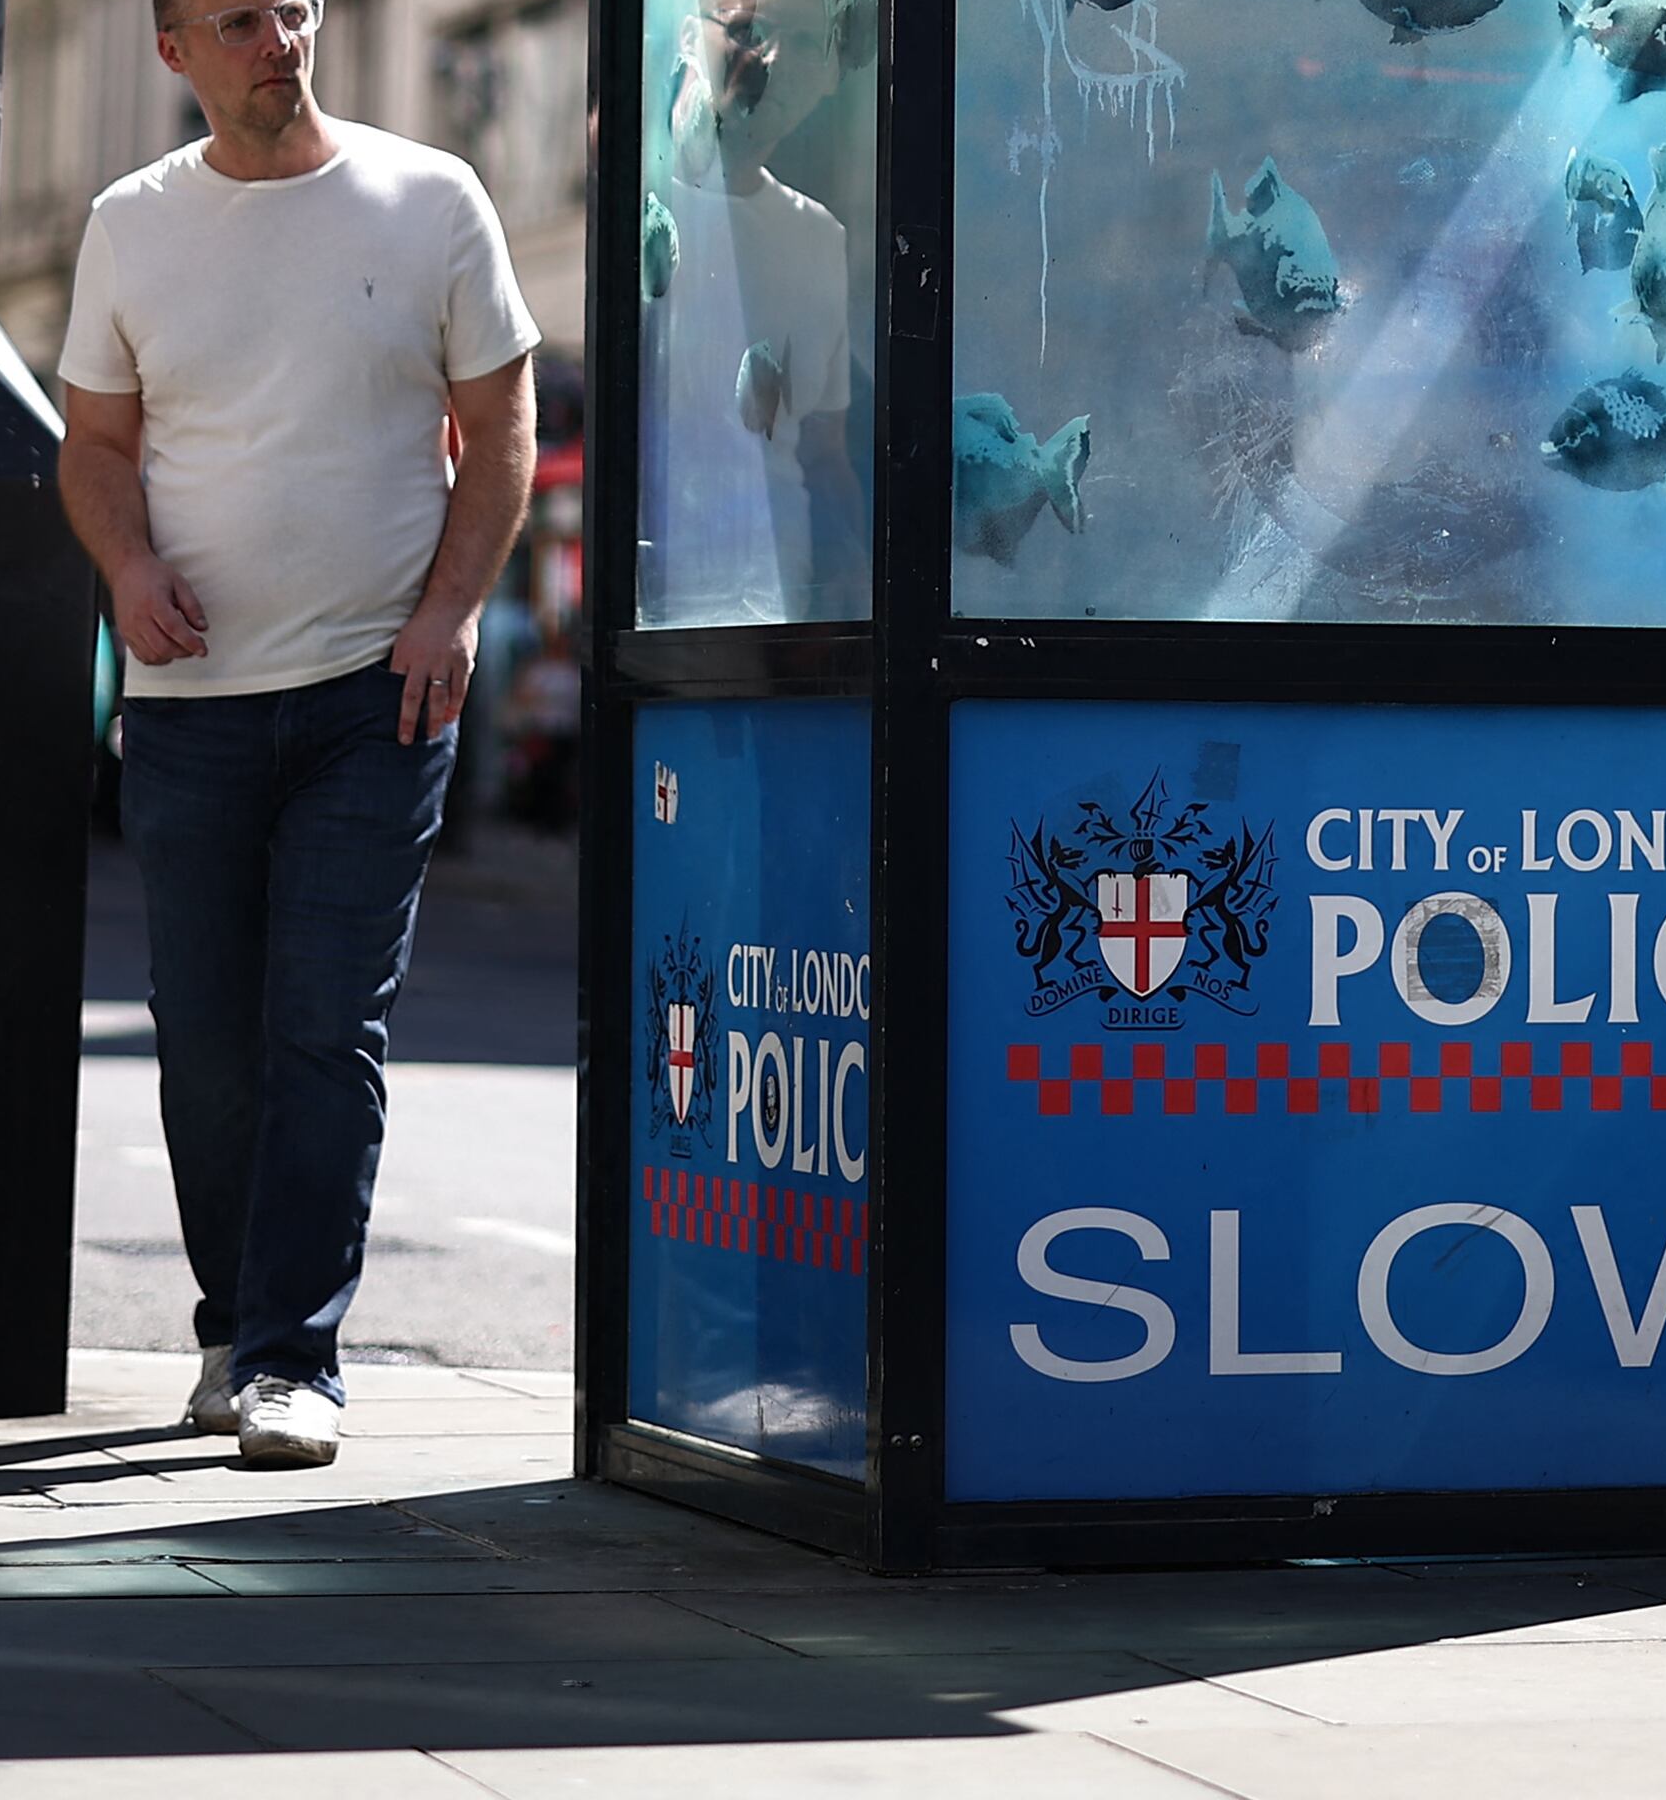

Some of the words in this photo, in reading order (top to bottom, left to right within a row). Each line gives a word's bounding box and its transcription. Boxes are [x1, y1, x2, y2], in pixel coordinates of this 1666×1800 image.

[1306, 808, 1465, 872] CITY
[1467, 845, 1508, 873] OF
[727, 943, 776, 1010] CITY
[775, 985, 789, 1014] OF
[791, 949, 871, 1021] LONDO
[1030, 967, 1105, 1012] DOMINE
[1108, 1007, 1179, 1025] DIRIGE
[1193, 970, 1233, 1002] NOS
[727, 1030, 866, 1184] POLIC
